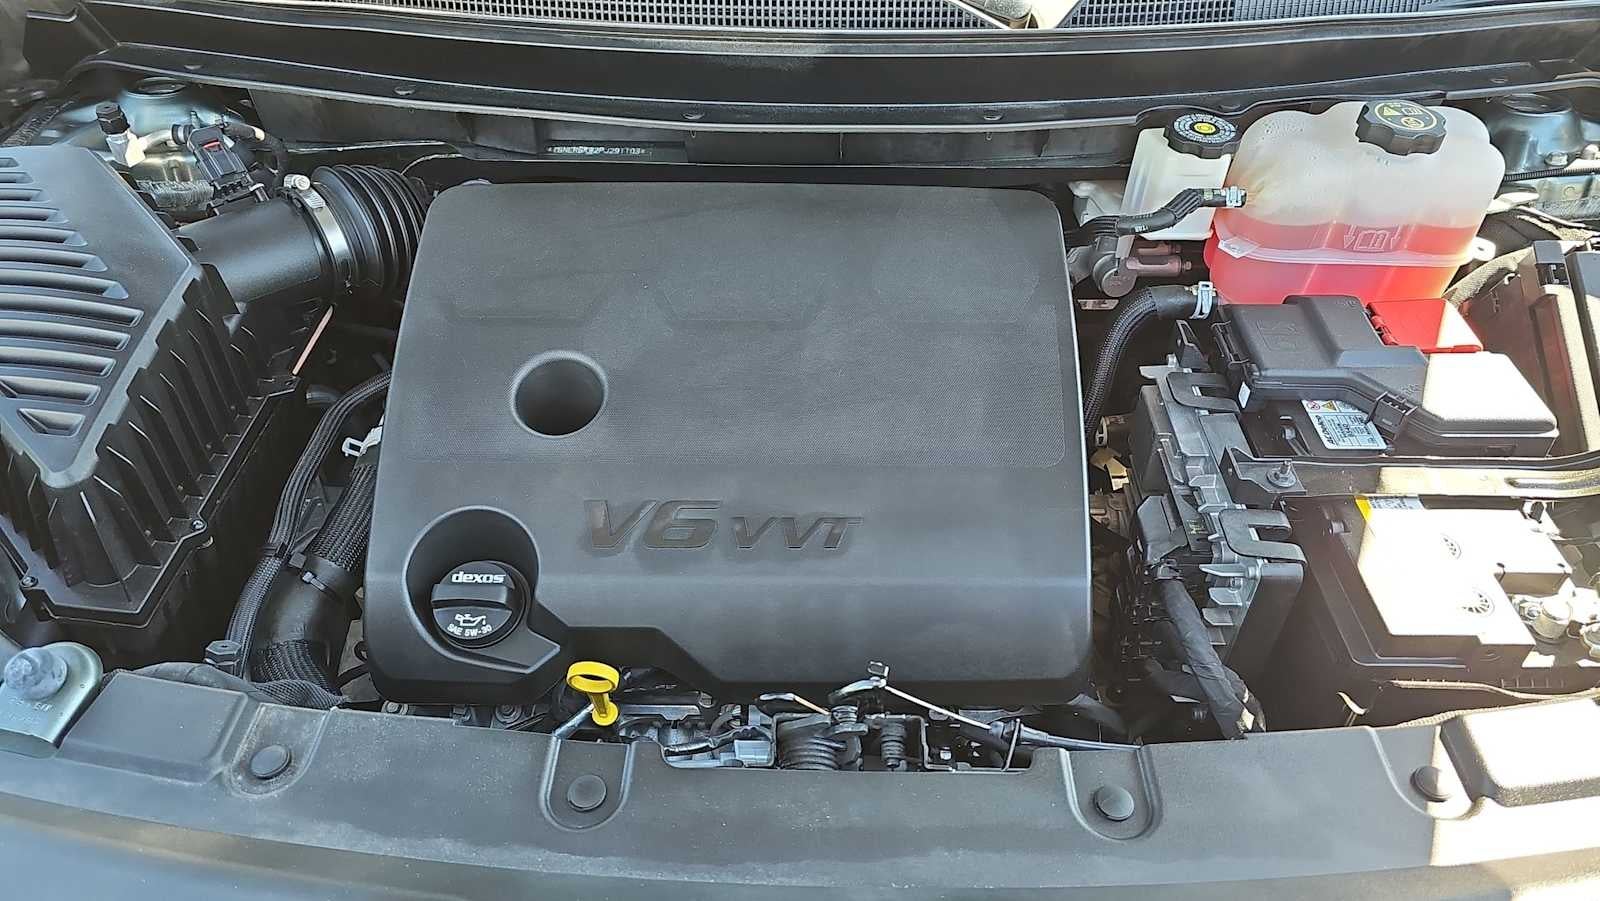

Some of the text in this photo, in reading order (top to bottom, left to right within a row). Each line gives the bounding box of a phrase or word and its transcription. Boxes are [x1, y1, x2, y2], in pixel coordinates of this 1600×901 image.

[584, 499, 865, 550] V6 VVT
[451, 571, 507, 584] dexos
[447, 623, 493, 637] SAE 5W-30
